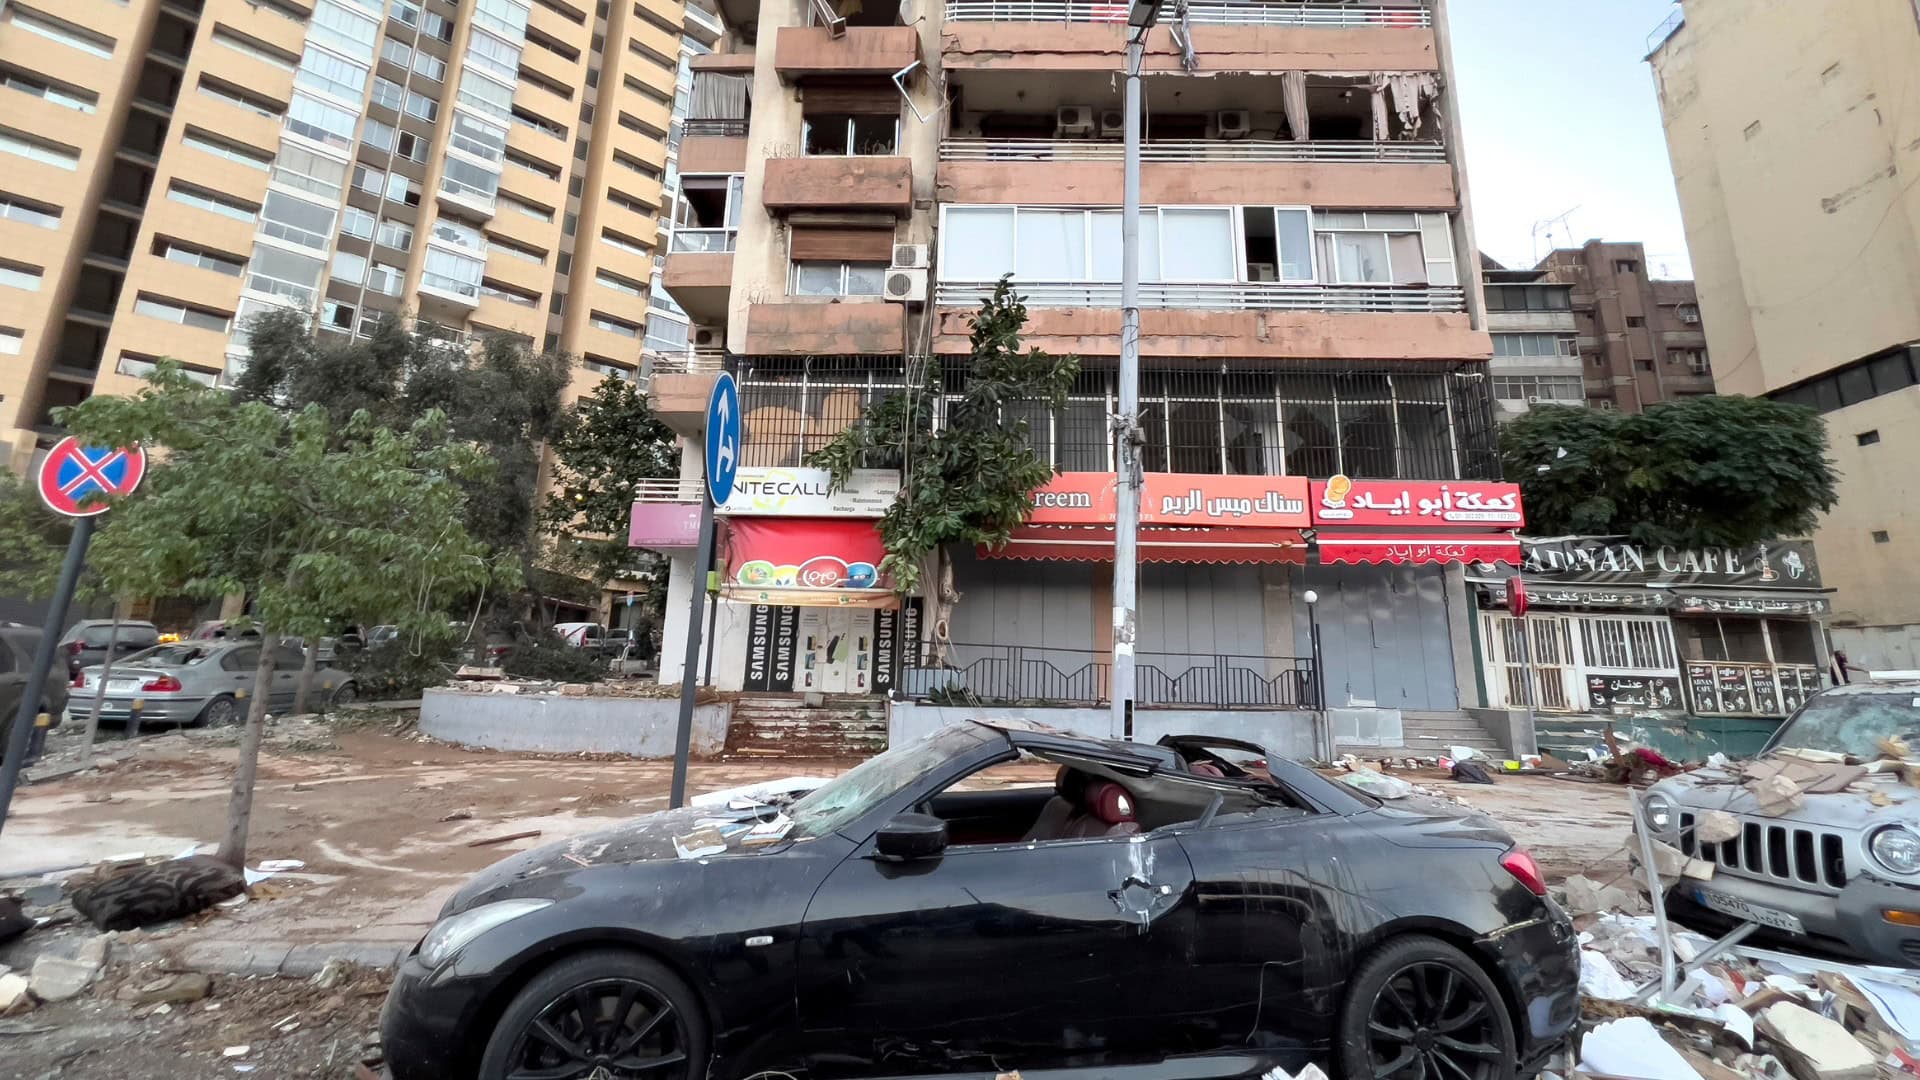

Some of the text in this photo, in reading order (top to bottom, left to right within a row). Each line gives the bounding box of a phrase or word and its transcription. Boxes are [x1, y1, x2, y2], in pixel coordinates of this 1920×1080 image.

[733, 481, 827, 496] NITECALL
[1034, 491, 1092, 507] reem
[1160, 489, 1304, 517] سناك ميس الريم
[1454, 491, 1517, 510] كعكة
[1656, 544, 1746, 575] CAFE
[1583, 592, 1618, 605] عدنان
[750, 604, 769, 681] SAMSUNG
[775, 605, 794, 682] SAMSUNG
[877, 608, 893, 684] SAMSUNG
[1610, 679, 1643, 691] عدنان
